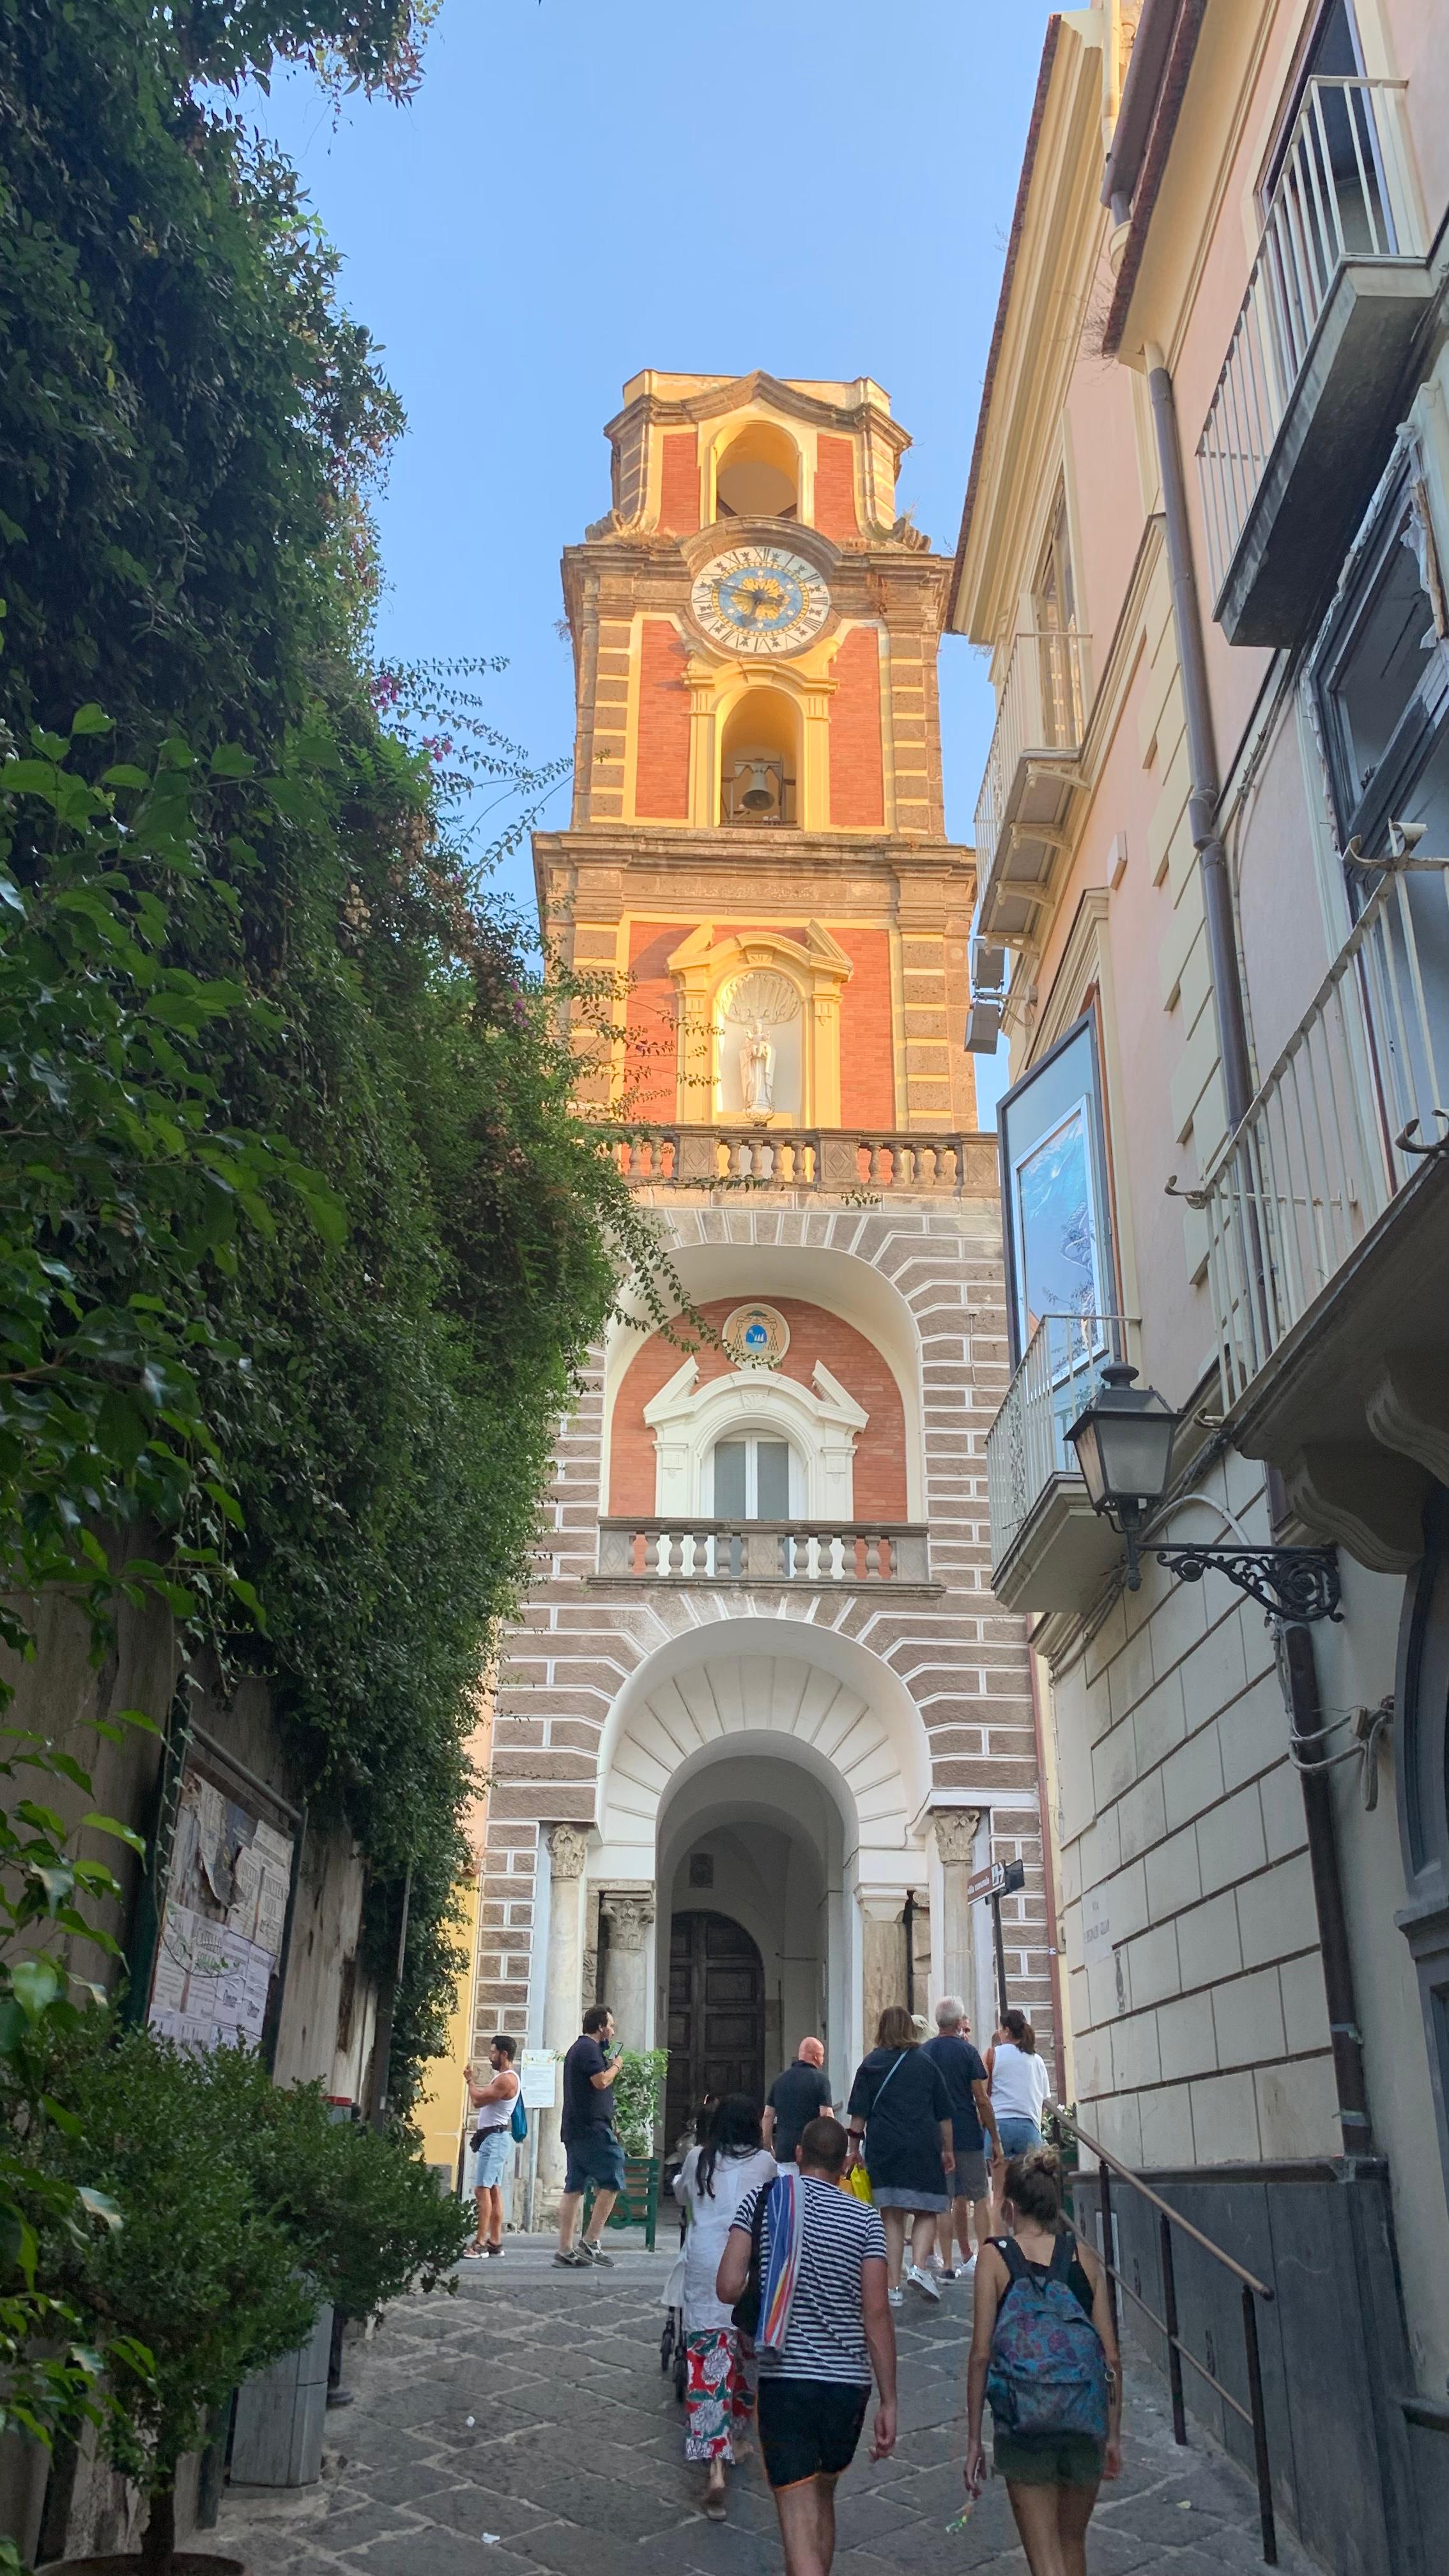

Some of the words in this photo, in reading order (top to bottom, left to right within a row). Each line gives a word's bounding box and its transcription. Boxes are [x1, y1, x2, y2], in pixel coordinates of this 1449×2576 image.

[754, 548, 770, 562] XII
[802, 573, 820, 583] II
[809, 597, 829, 606] III
[802, 617, 823, 632] IIII
